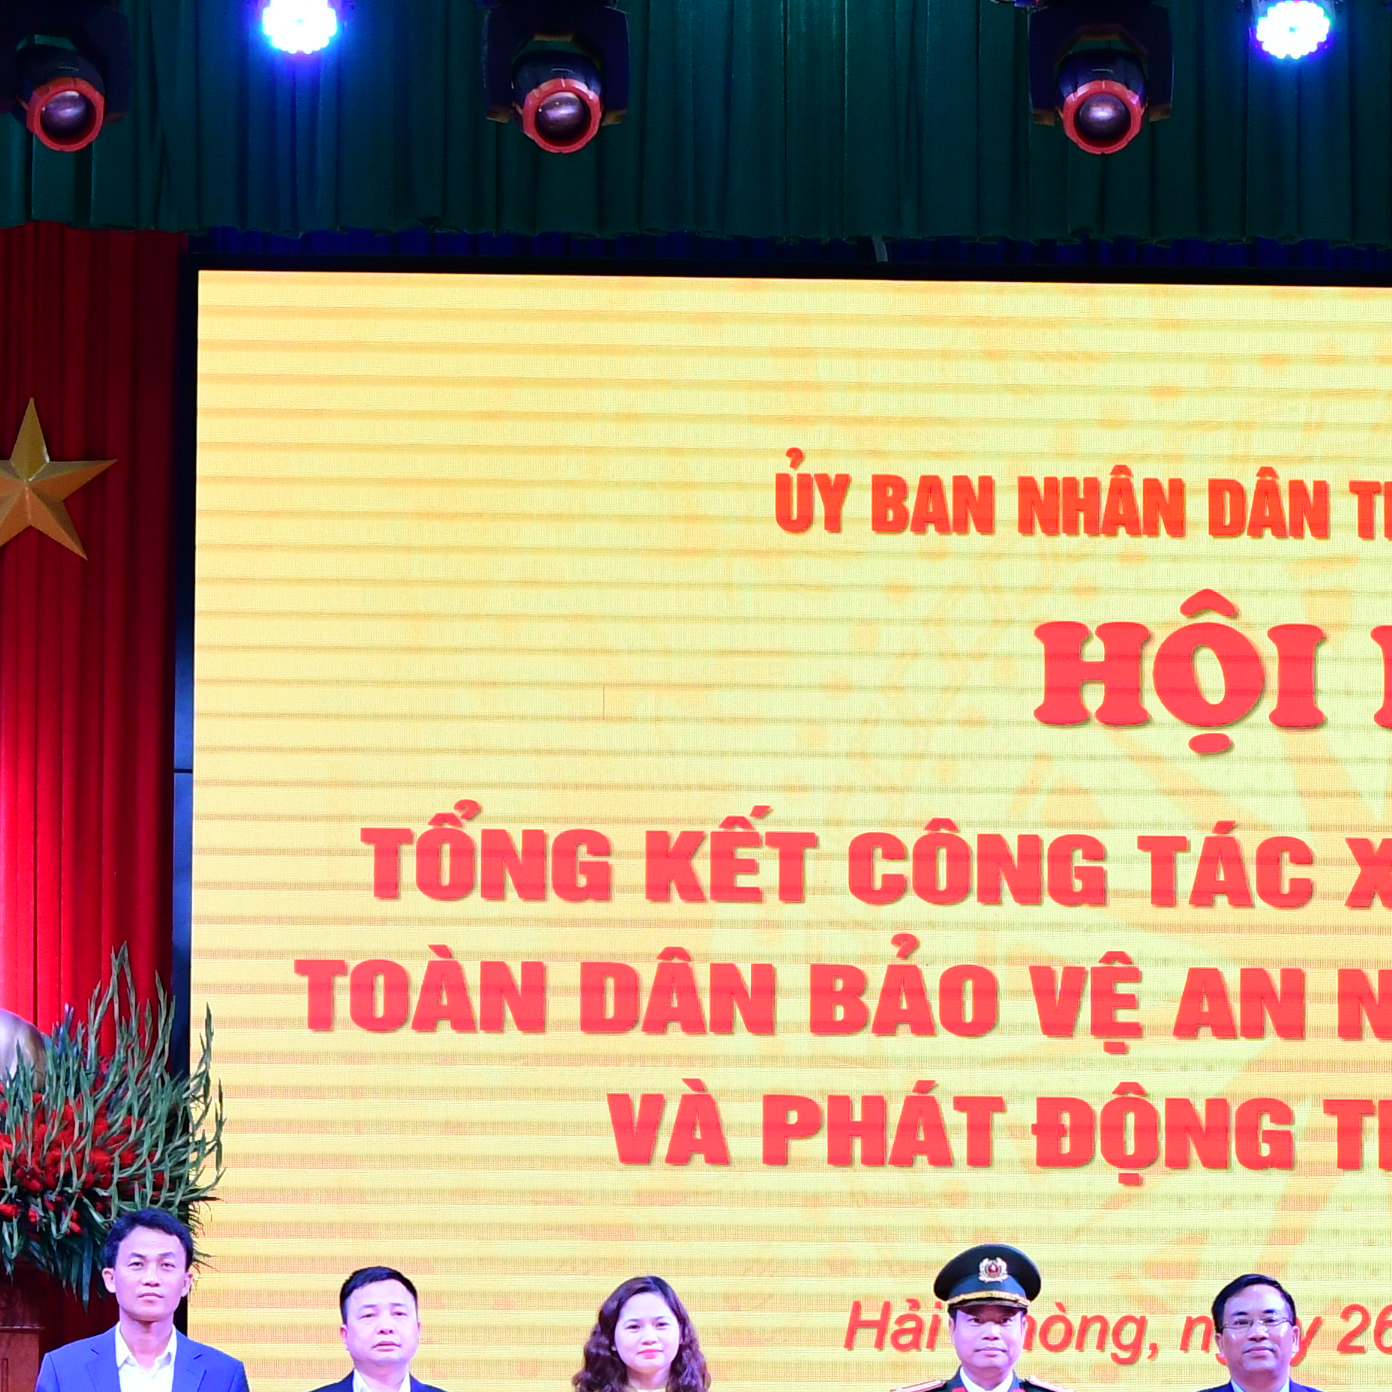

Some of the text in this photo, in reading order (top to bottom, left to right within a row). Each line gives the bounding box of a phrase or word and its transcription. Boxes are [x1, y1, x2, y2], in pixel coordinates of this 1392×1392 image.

[775, 447, 852, 534] ỦY
[871, 474, 994, 535] BAN
[1018, 464, 1185, 538] NHÂN
[1208, 466, 1329, 539] DÂN
[1033, 587, 1326, 755] HỘI
[361, 798, 612, 903] TỔNG
[645, 804, 819, 903] KẾT
[847, 817, 1108, 907] CÔNG
[1137, 820, 1314, 909] TÁC
[295, 943, 546, 1033] TOÀN
[580, 946, 777, 1035] DÂN
[810, 932, 999, 1038] BẢO
[1029, 950, 1144, 1054] VỆ
[1172, 967, 1306, 1040] AN
[607, 1077, 731, 1167] VÀ
[762, 1079, 1006, 1168] PHÁT
[1031, 1081, 1295, 1187] ĐỘNG
[843, 1298, 943, 1351] Hải
